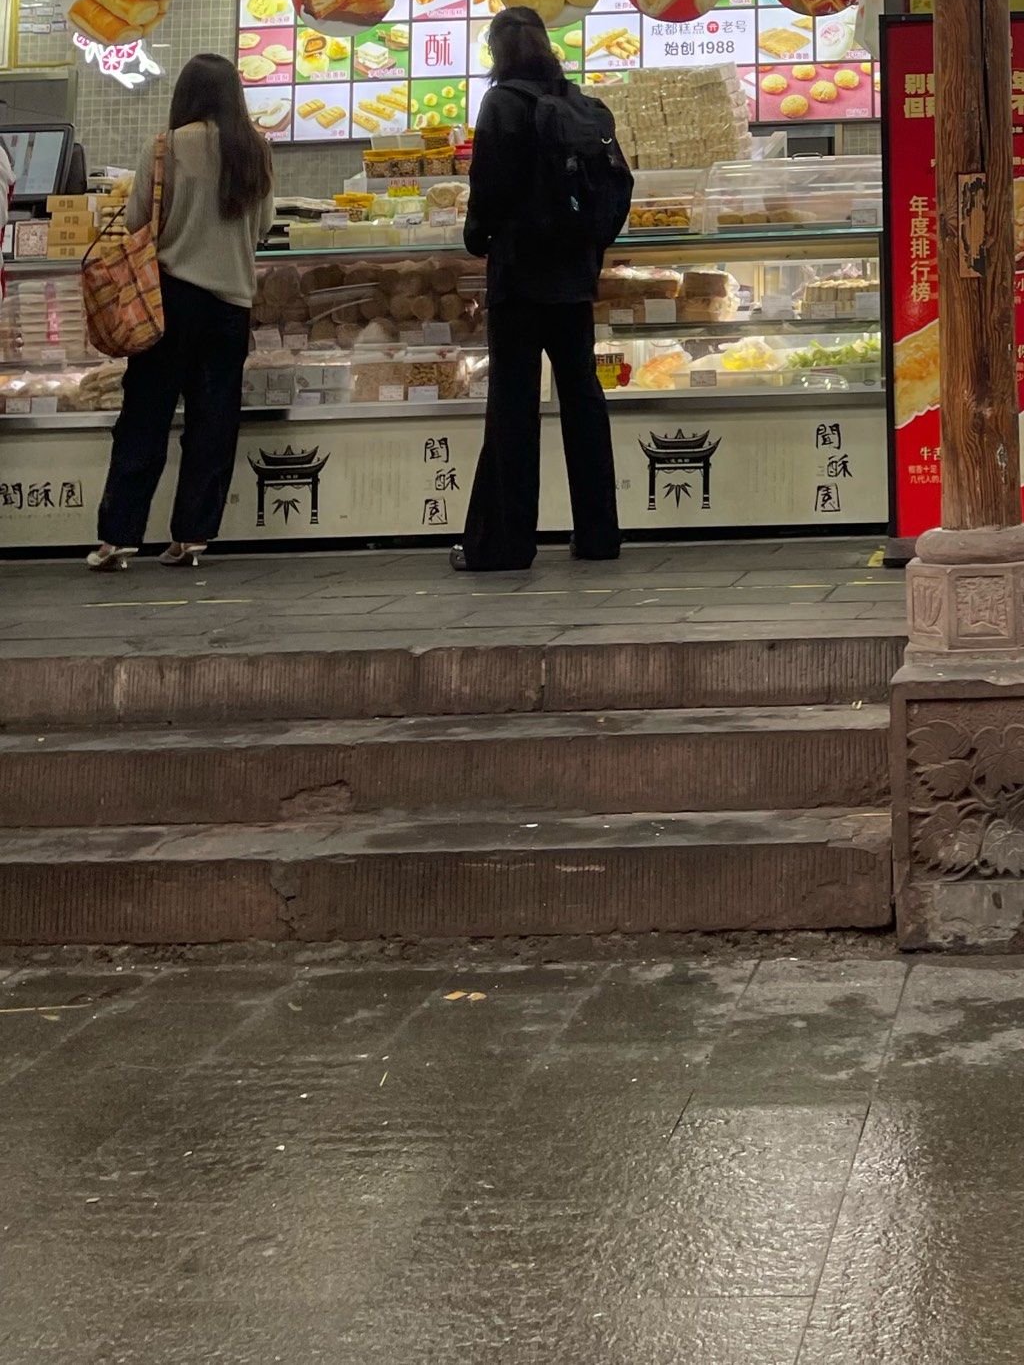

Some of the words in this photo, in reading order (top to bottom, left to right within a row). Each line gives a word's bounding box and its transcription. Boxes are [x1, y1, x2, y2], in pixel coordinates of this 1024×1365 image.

[909, 195, 931, 303] 年度排行榜
